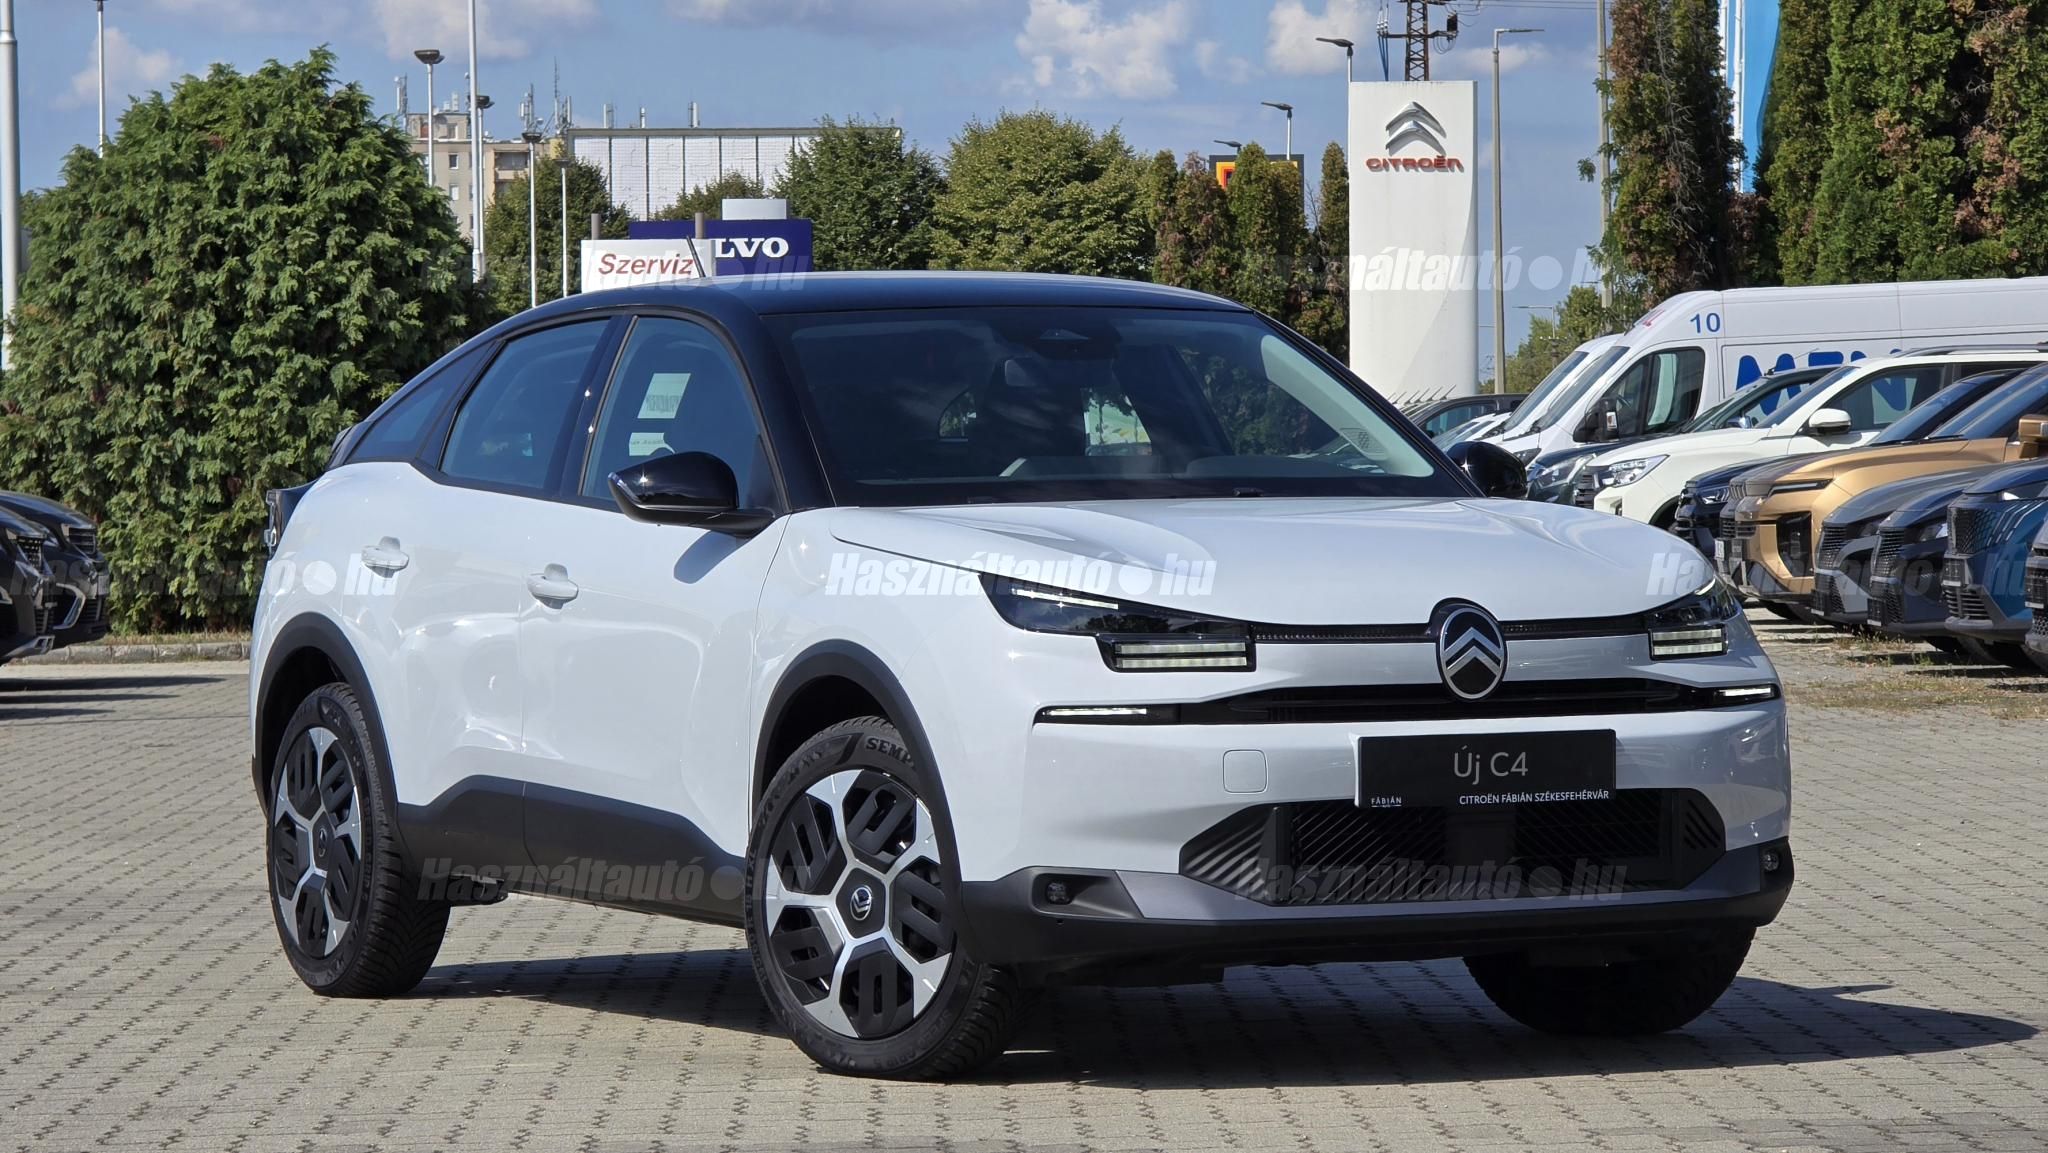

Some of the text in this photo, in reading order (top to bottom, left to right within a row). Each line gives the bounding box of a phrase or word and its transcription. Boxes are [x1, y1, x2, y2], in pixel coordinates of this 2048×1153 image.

[715, 237, 789, 258] LVO
[598, 252, 694, 275] Szerviz
[1690, 312, 1720, 334] 10
[1454, 745, 1529, 785] Új C4
[1459, 788, 1610, 805] CITROËN FÁBIÁN SZÉKESFEHÉRVÁR
